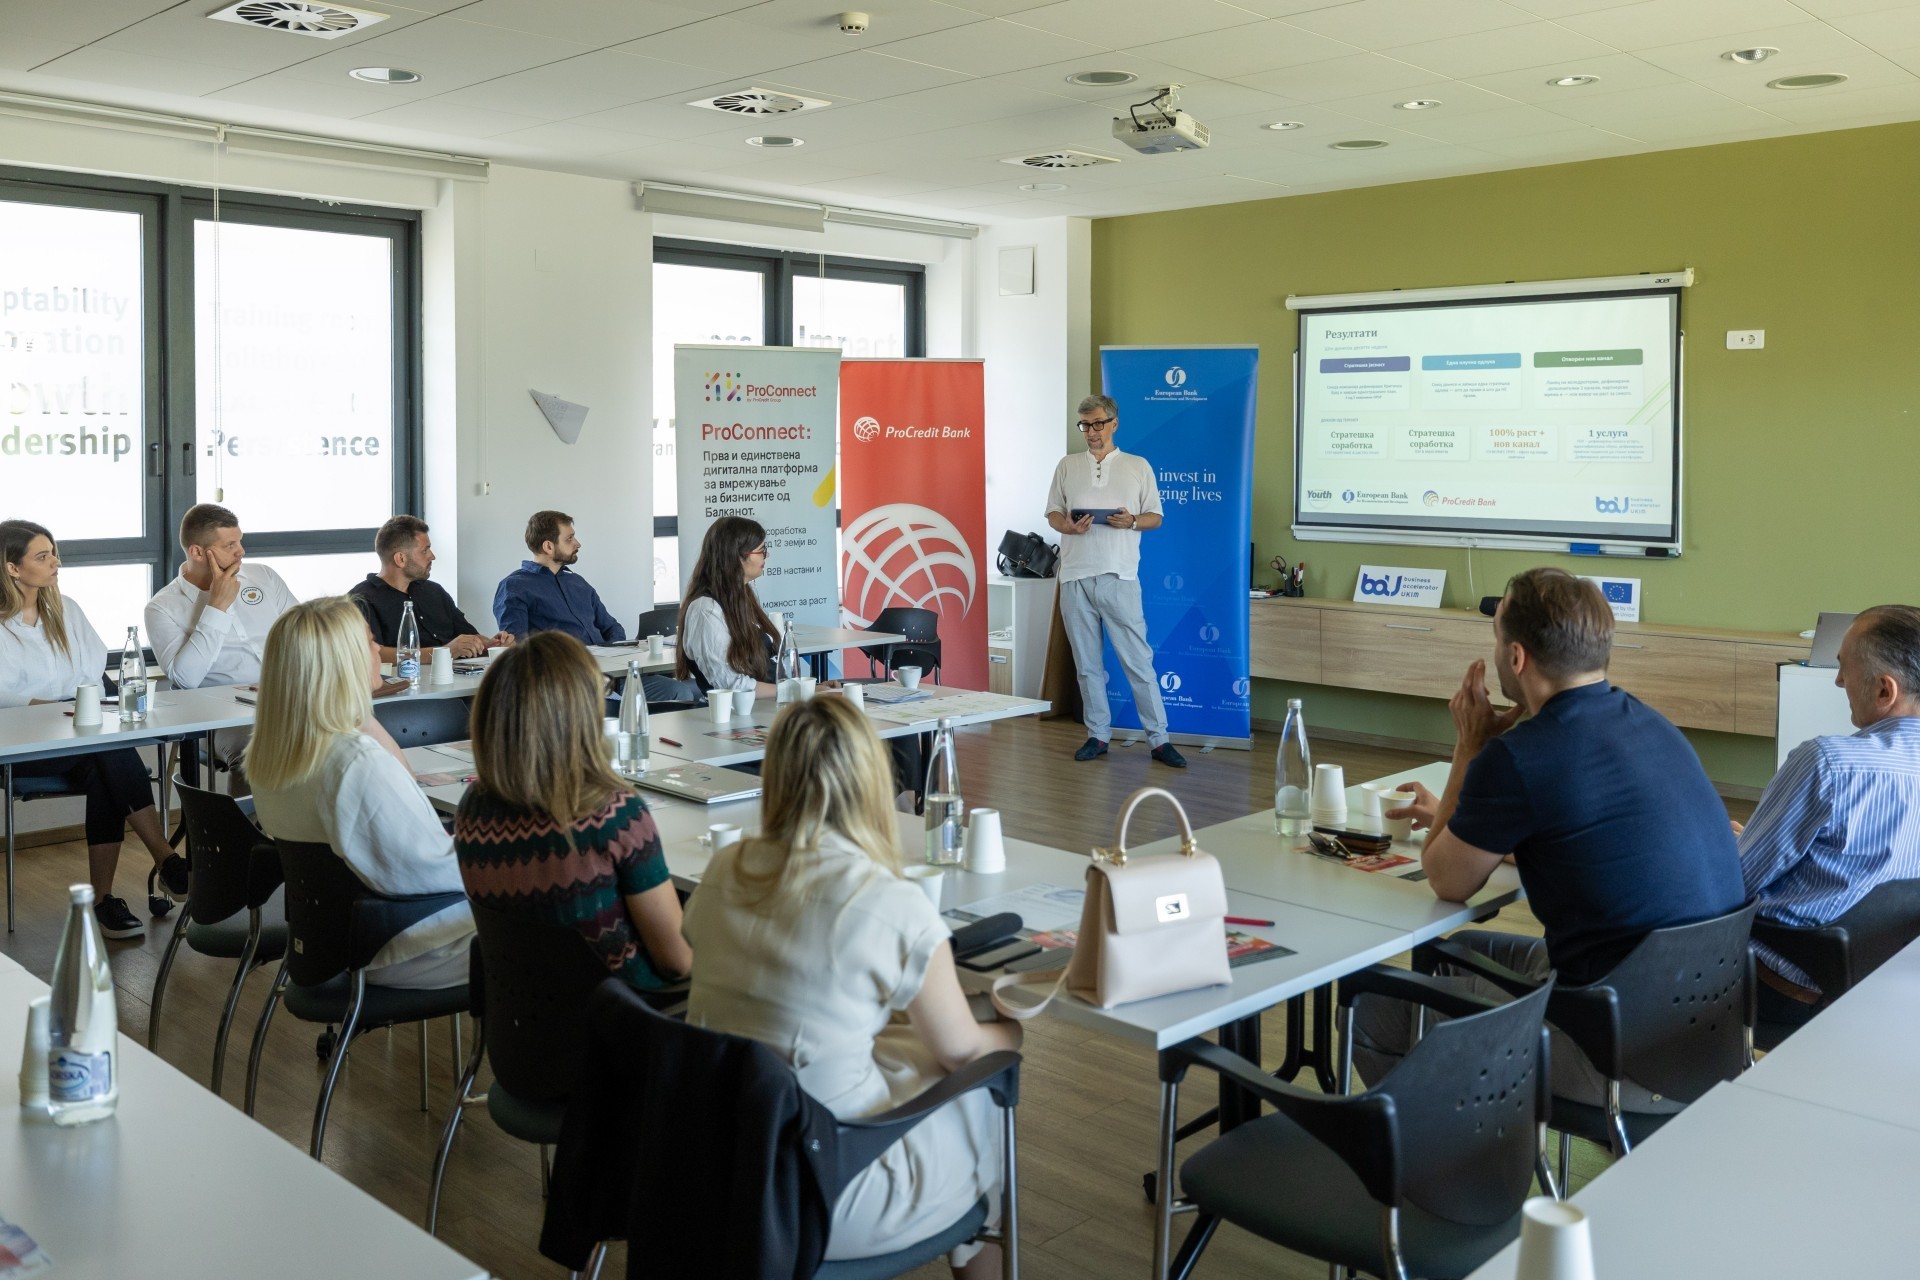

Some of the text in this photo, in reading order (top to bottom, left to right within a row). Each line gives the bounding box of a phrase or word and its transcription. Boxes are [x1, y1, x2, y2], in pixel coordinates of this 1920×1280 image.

[1325, 329, 1378, 341] Резултати
[746, 384, 816, 397] ProConnect
[1155, 389, 1182, 397] European
[702, 422, 811, 440] ProConnect:
[885, 426, 971, 438] ProCredit Bank
[1330, 431, 1375, 441] Стратешка
[1408, 429, 1455, 439] Стратешка
[1489, 428, 1515, 437] 100%
[1516, 429, 1537, 439] раст
[1588, 429, 1628, 439] 1 услуга
[1, 425, 132, 463] dership
[1331, 441, 1373, 450] соработка
[1409, 440, 1454, 449] соработка
[703, 450, 801, 463] Прва и единствена
[703, 463, 818, 477] дигитална платформа
[1159, 468, 1216, 483] invest in
[704, 478, 786, 491] за вмрежување
[704, 492, 791, 503] на бизнисите од
[1192, 486, 1222, 502] lives
[1307, 490, 1333, 499] Youth
[1357, 491, 1409, 500] European Bank
[1442, 496, 1497, 506] ProCredit Bank
[705, 507, 755, 518] Балканот.
[765, 526, 807, 537] соработка
[774, 539, 782, 547] 12
[784, 538, 806, 548] земји
[784, 566, 815, 575] настани
[763, 599, 797, 609] можност
[809, 597, 828, 607] раст
